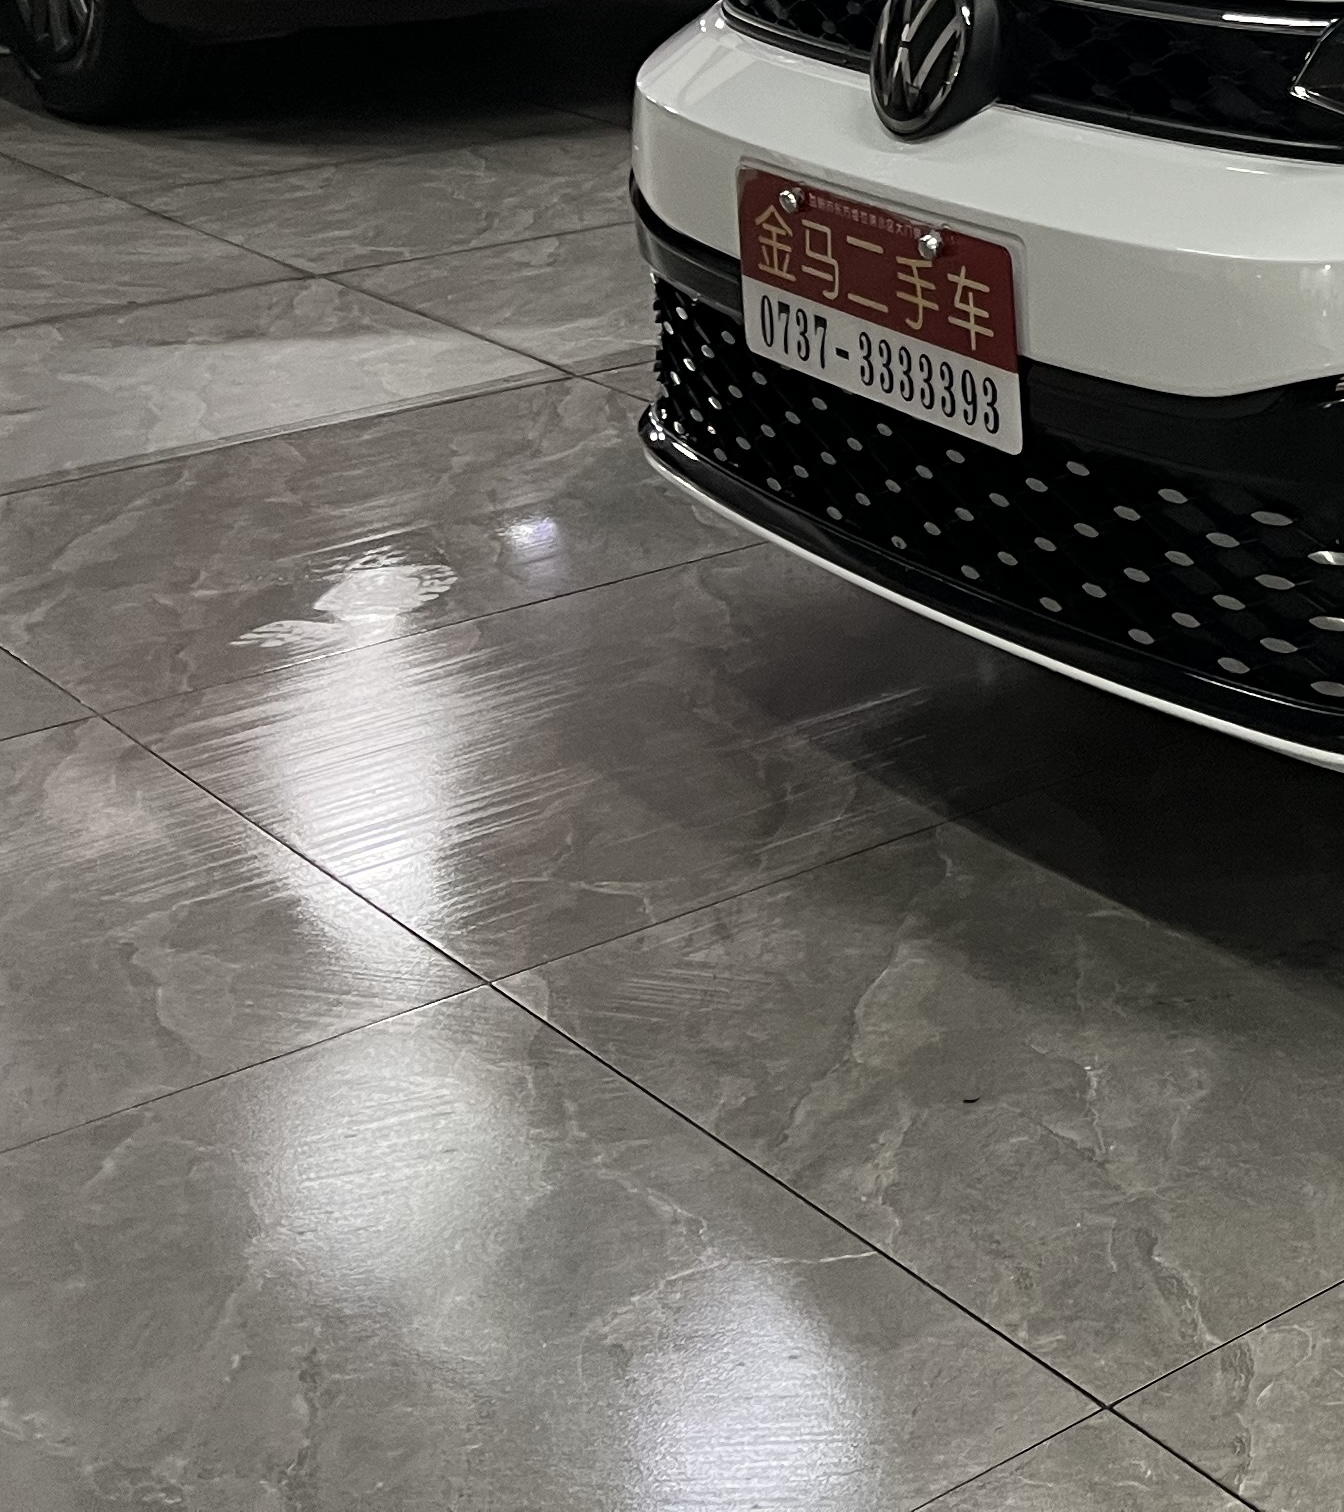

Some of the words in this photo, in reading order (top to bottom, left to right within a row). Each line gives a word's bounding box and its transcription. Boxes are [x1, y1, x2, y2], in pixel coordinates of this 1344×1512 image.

[755, 205, 995, 351] 金马二手车
[760, 294, 999, 434] 0737-3333393
